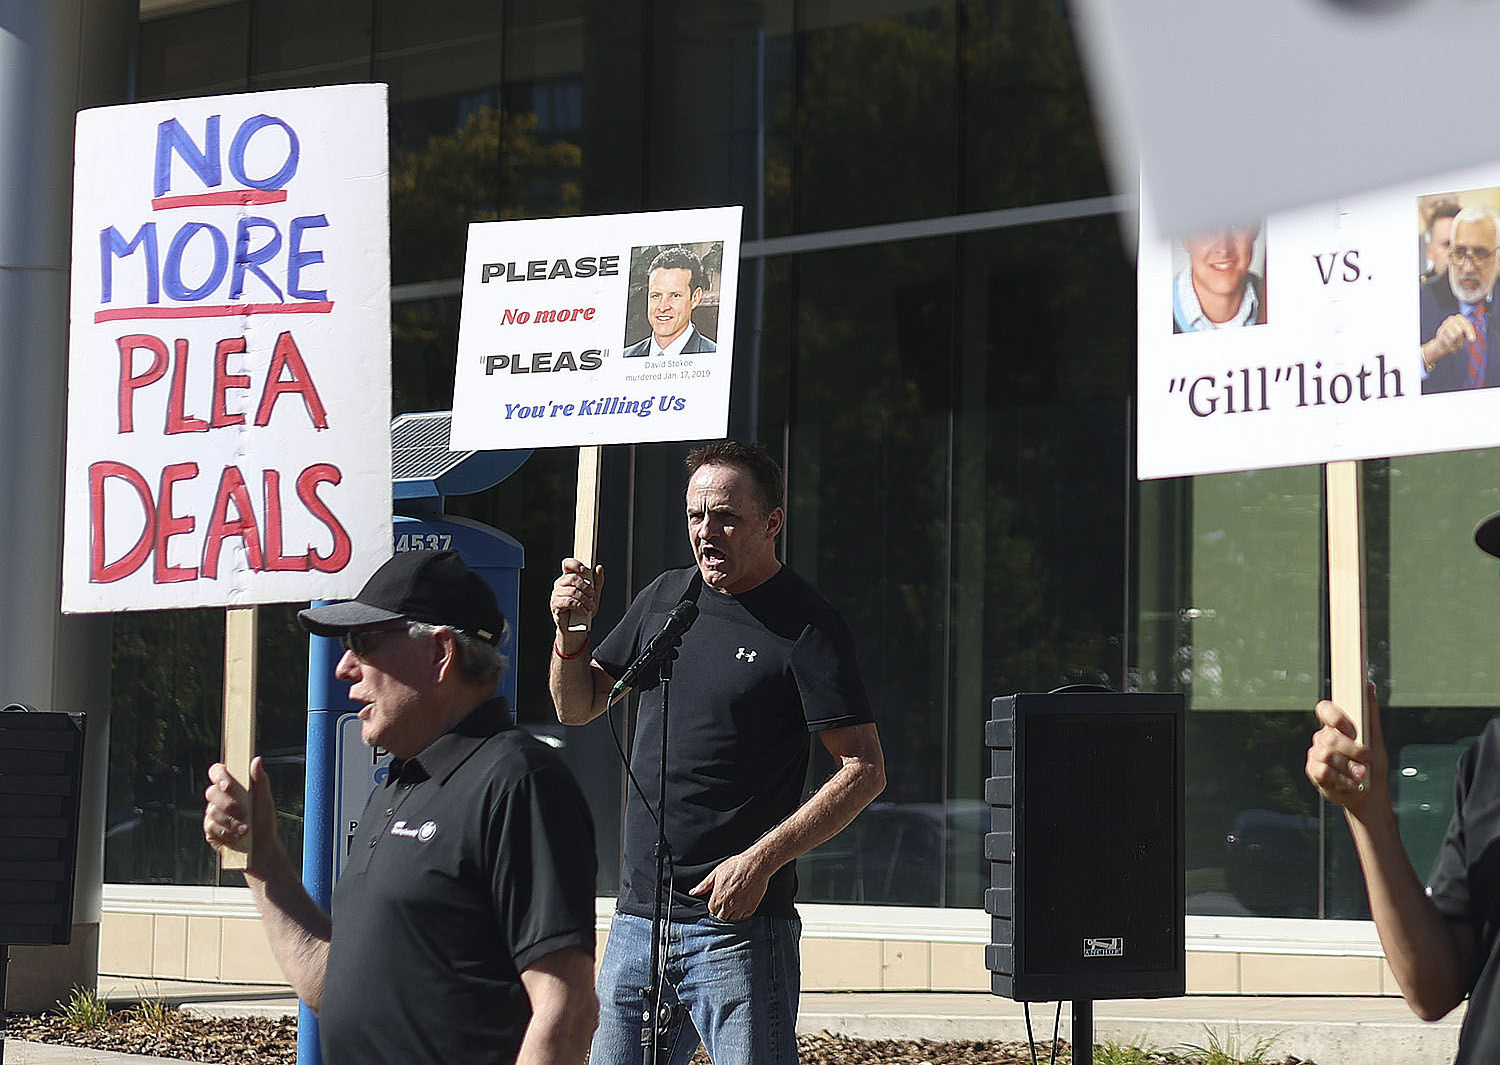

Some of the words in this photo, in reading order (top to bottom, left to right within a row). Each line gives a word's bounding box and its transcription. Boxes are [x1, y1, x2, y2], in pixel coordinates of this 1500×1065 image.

[154, 114, 299, 197] NO
[100, 214, 330, 304] MORE
[481, 255, 620, 284] PLEASE
[1313, 249, 1373, 285] vs.
[500, 308, 530, 326] No
[534, 306, 596, 324] more
[479, 348, 610, 375] "PLEAS"
[625, 372, 662, 382] murdered
[691, 369, 711, 378] 2019
[644, 359, 666, 369] David
[116, 331, 328, 434] PLEA
[505, 401, 575, 420] You're
[578, 396, 655, 418] Killing
[658, 396, 686, 412] Us
[88, 460, 352, 584] DEALS
[393, 534, 452, 553] 4537
